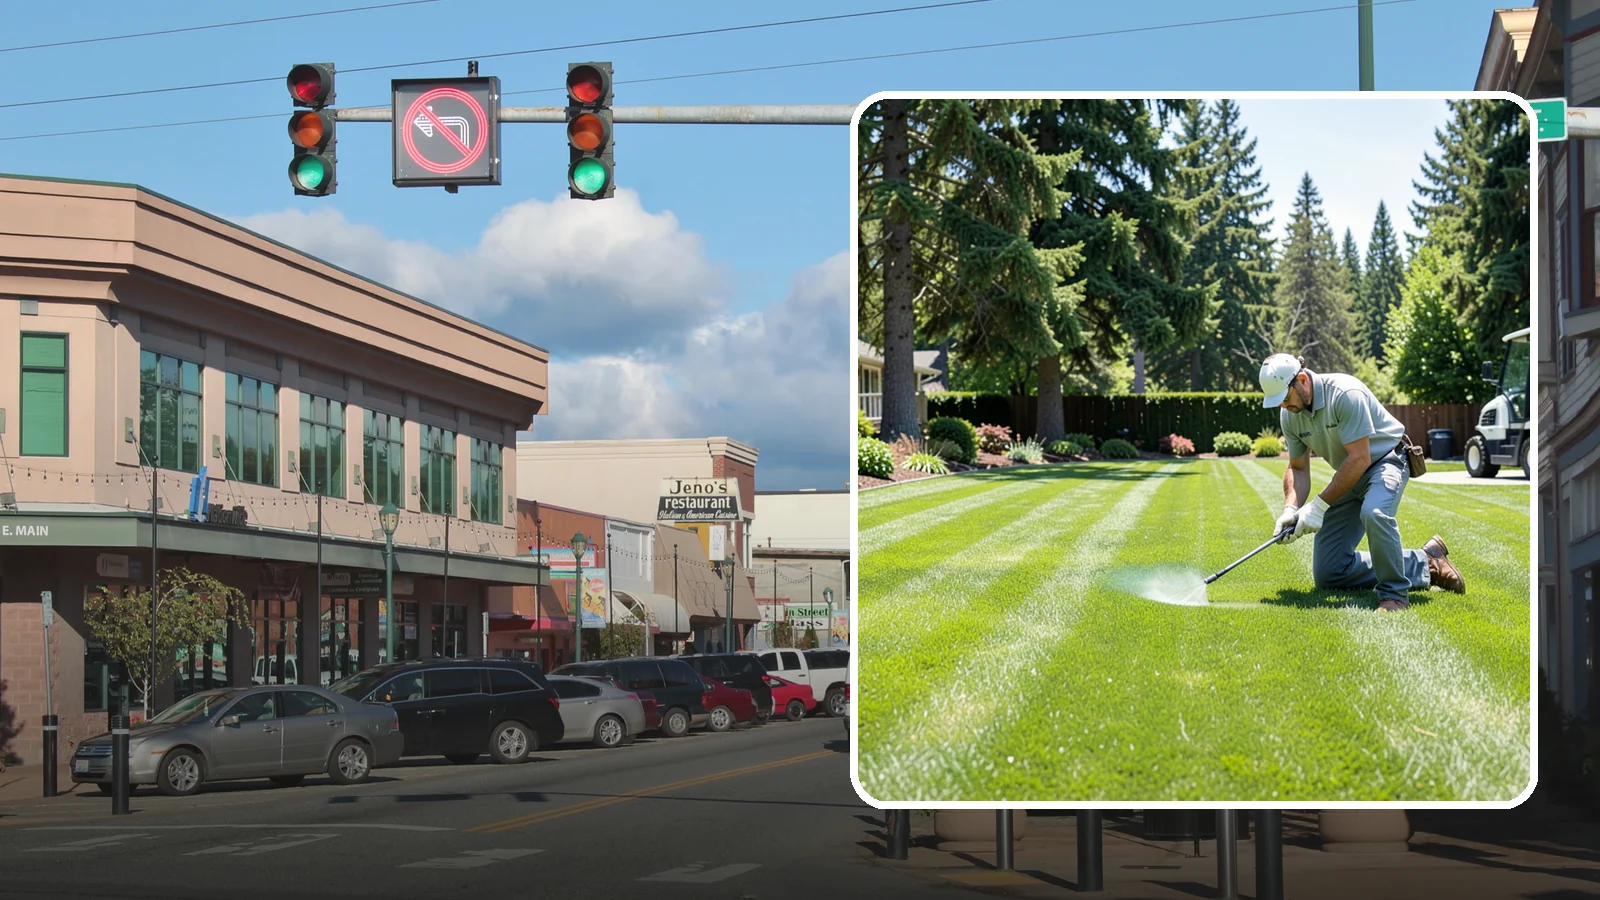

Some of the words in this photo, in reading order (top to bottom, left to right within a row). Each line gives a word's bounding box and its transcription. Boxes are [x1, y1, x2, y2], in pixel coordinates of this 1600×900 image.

[670, 480, 727, 494] Jeno's
[665, 497, 731, 509] restaurant
[659, 510, 682, 519] Italian
[686, 510, 714, 519] American
[715, 509, 737, 519] Cuisine
[2, 525, 13, 536] E.
[16, 525, 48, 536] MAIN
[797, 608, 828, 617] Street
